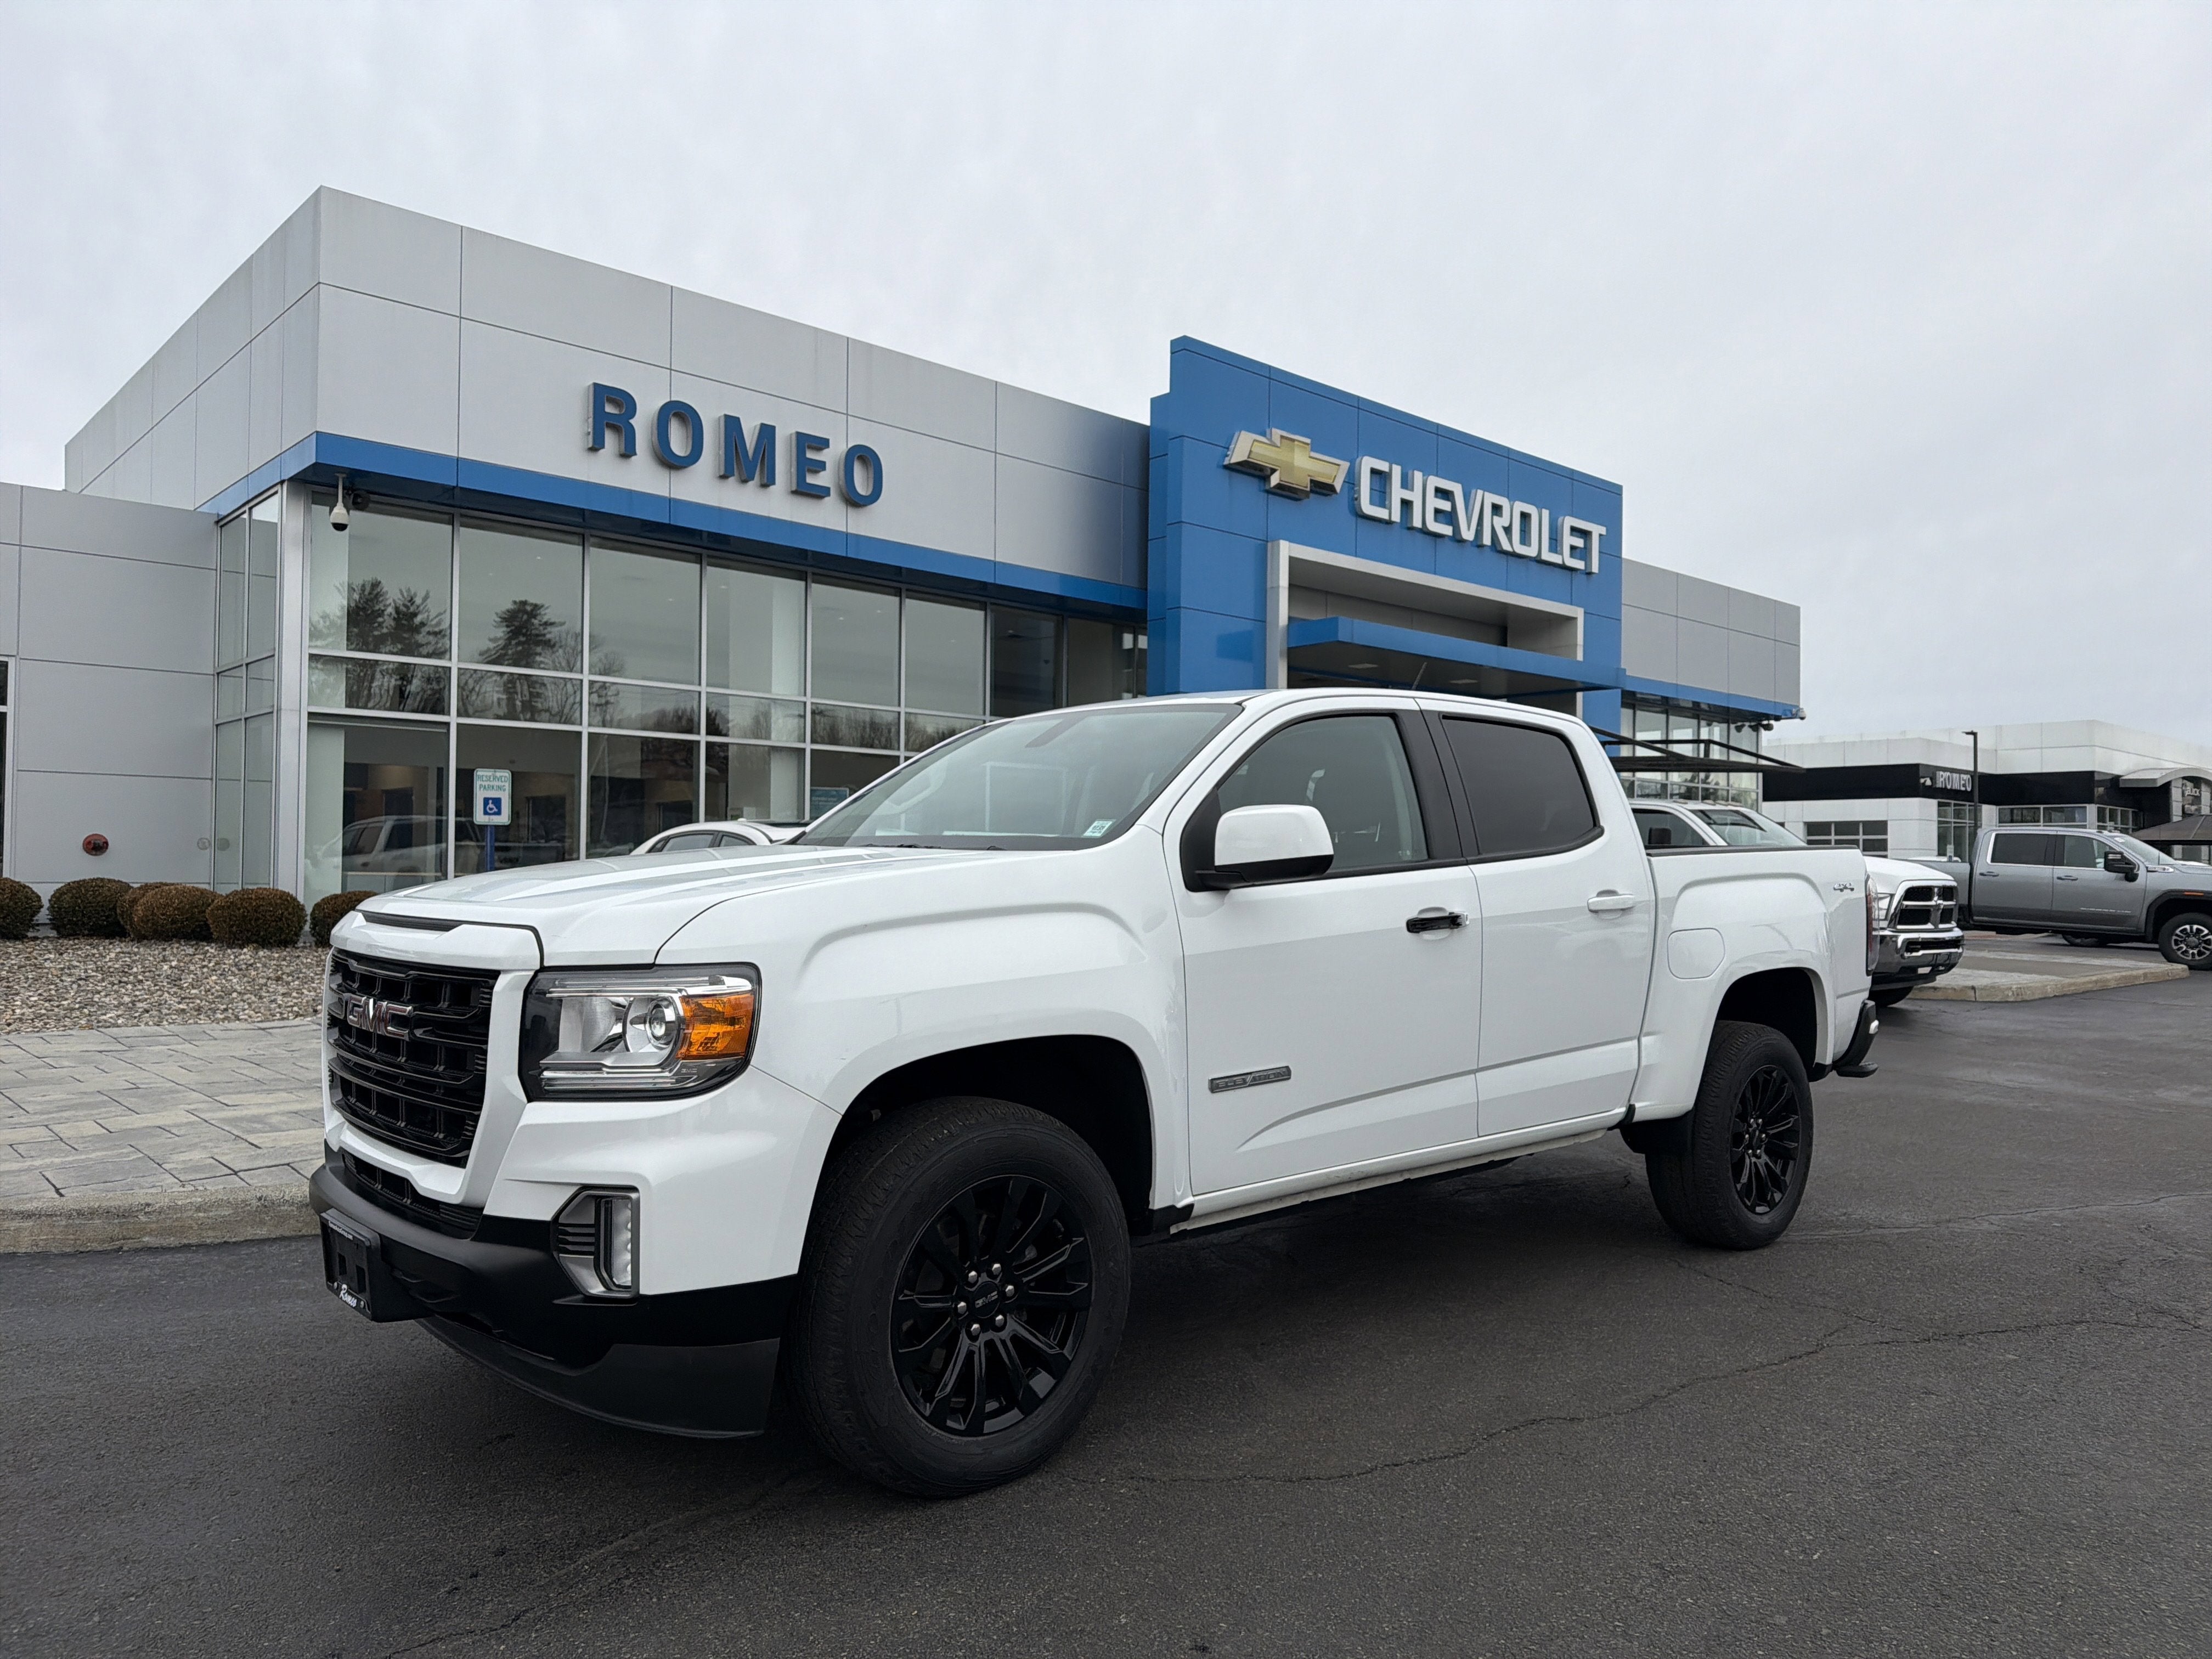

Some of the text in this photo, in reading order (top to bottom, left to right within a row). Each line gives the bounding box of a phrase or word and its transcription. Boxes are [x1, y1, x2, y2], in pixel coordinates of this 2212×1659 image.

[588, 382, 883, 507] ROMEO
[1356, 456, 1607, 574] CHEVROLET
[477, 774, 509, 783] RESERVED
[1936, 771, 1972, 792] ROMEO
[347, 995, 413, 1041] GMC
[1216, 1069, 1287, 1088] ELEVATION
[974, 1290, 998, 1308] GMC
